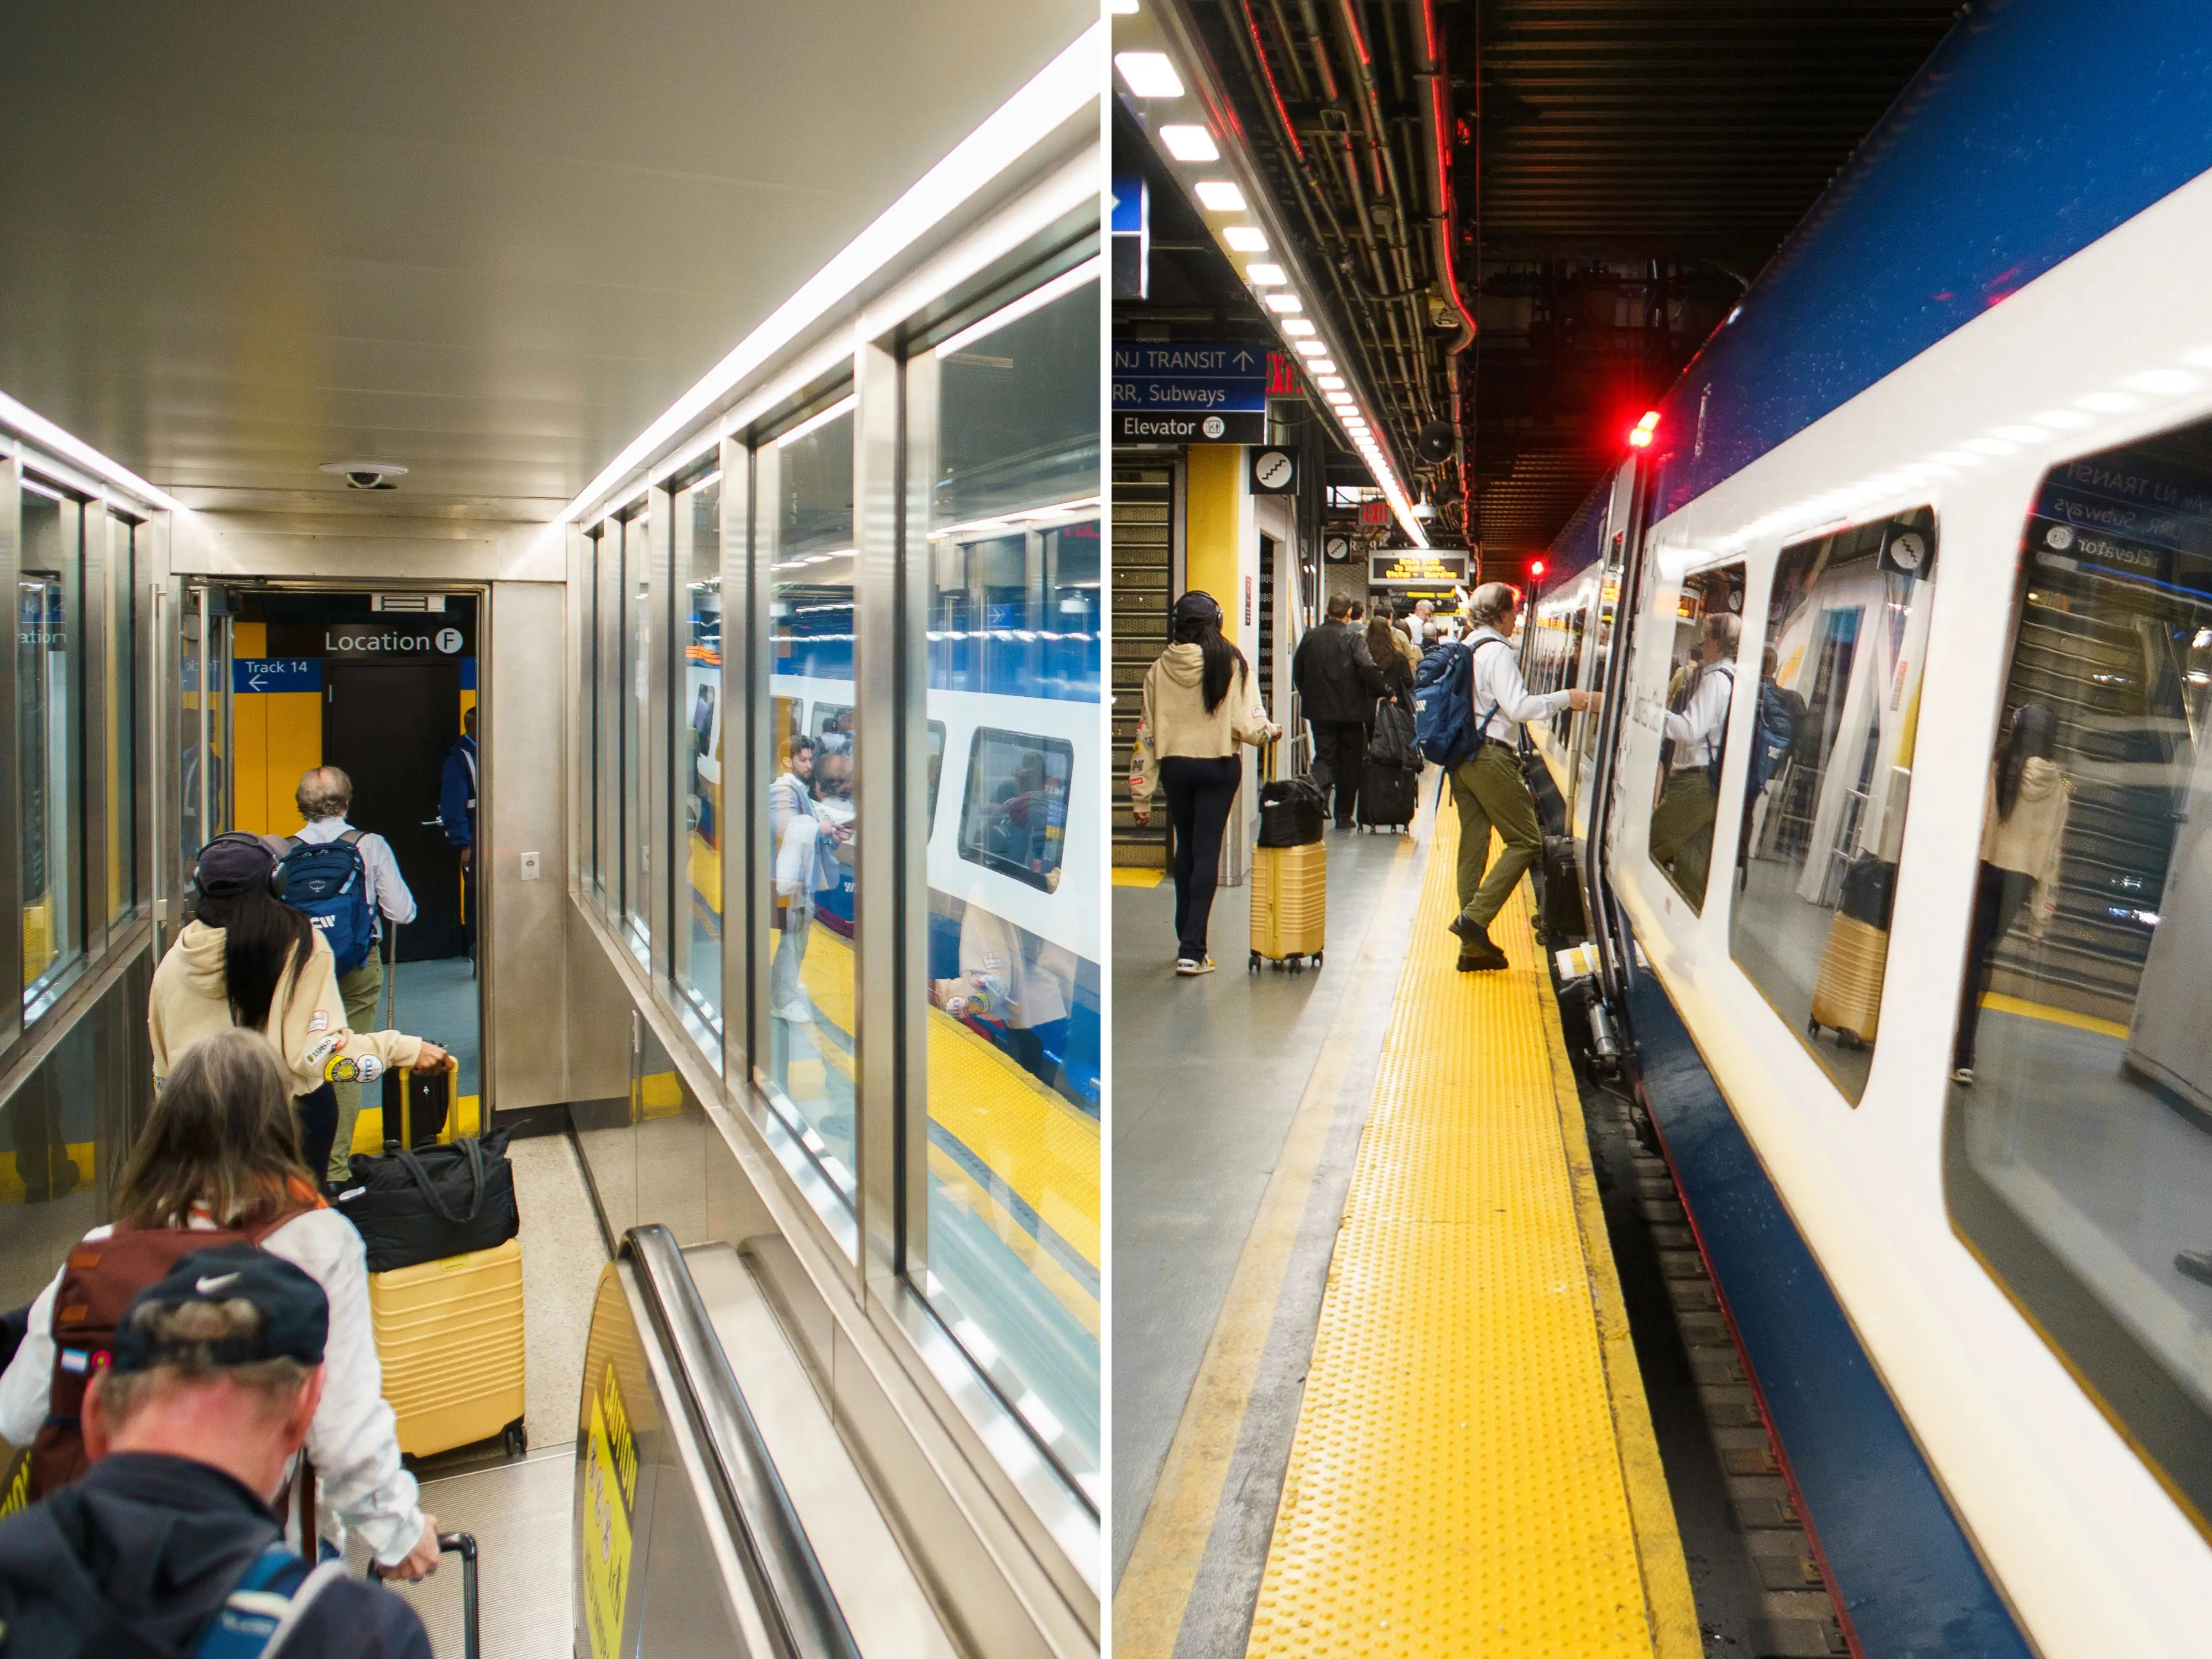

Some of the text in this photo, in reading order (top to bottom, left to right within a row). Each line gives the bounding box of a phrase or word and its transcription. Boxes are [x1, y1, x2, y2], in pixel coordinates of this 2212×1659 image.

[1115, 351, 1226, 368] NJ TRANSIT
[1113, 384, 1225, 408] RR, Subways
[1124, 418, 1196, 435] Elevator
[325, 632, 455, 651] Location F
[246, 661, 308, 673] Track 14
[604, 1363, 637, 1513] CAUTION
